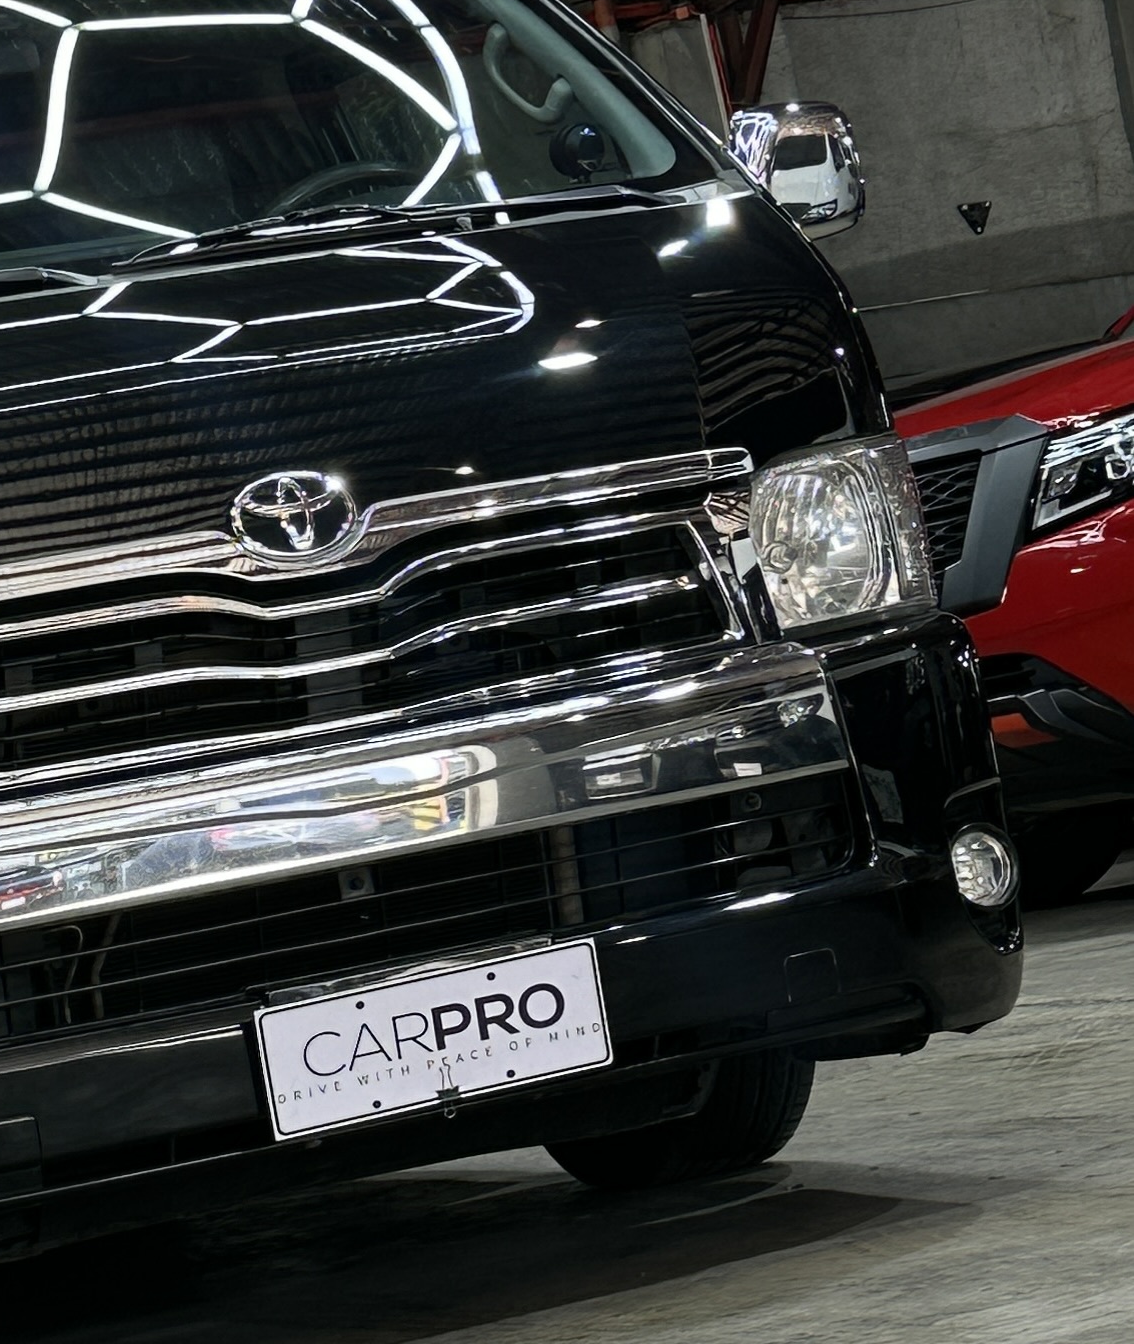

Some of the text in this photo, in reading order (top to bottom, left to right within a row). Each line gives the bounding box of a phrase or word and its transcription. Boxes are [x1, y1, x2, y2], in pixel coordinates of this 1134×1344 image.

[277, 1021, 602, 1105] DRIVE WITH PEACE OF MIND
[303, 982, 566, 1077] CARPRO
